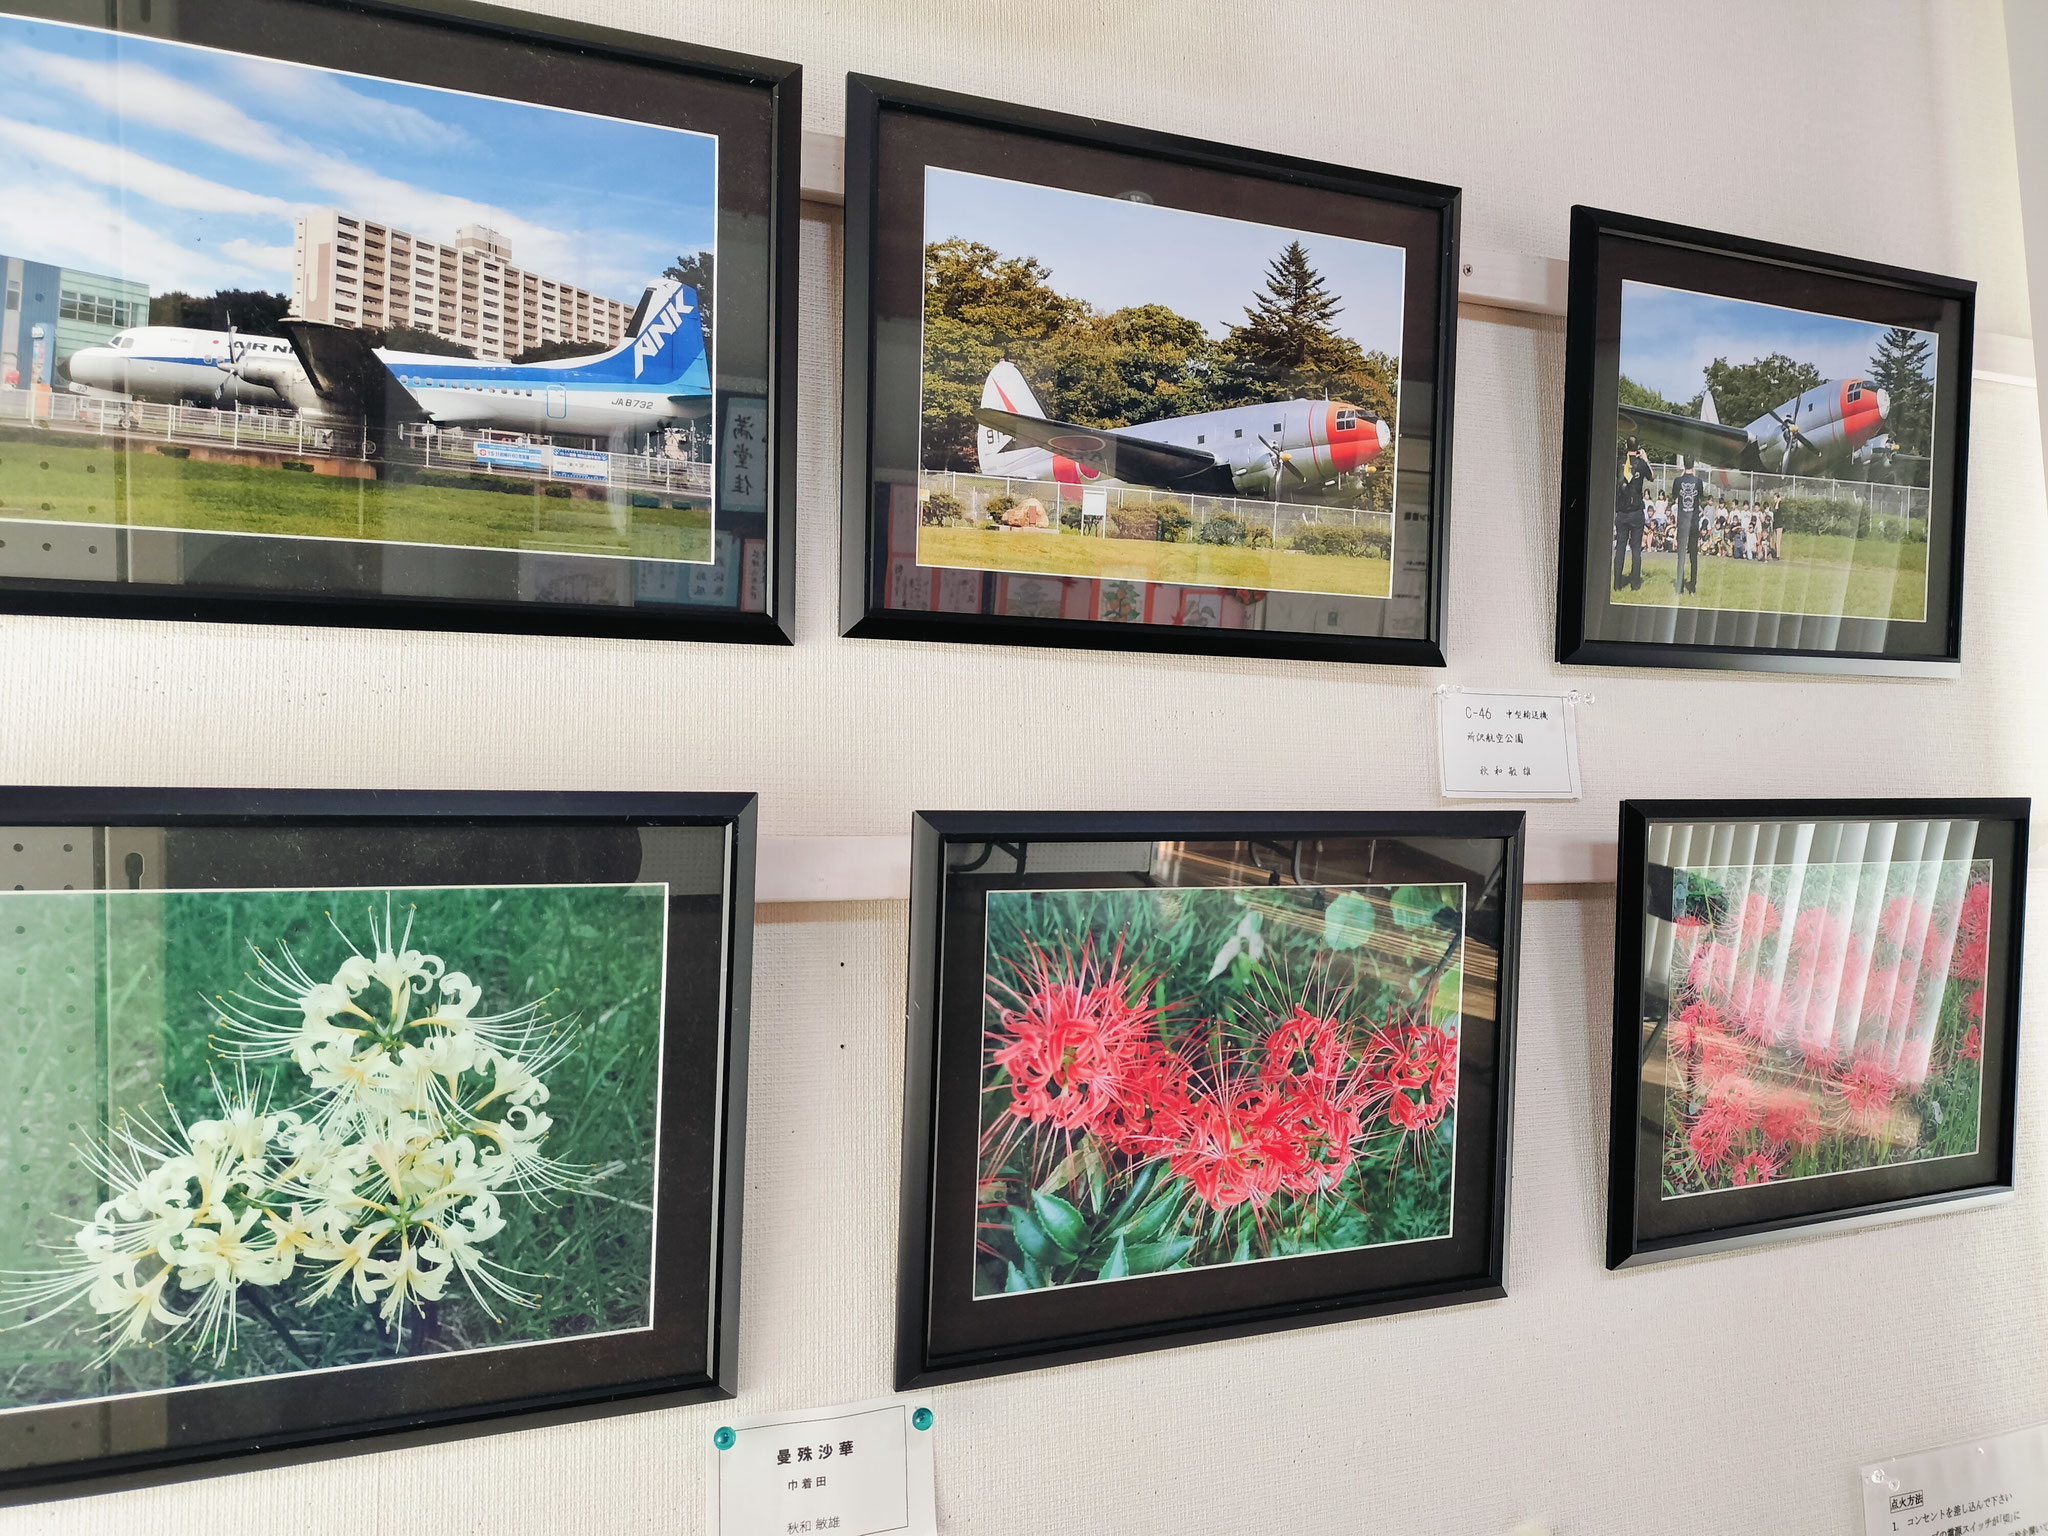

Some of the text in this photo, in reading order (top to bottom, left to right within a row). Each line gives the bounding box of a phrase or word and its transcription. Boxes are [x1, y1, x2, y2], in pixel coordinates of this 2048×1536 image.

[1465, 706, 1492, 720] C-46
[1467, 731, 1524, 744] 所沢航空公園
[777, 1440, 854, 1466] 曼殊沙華
[787, 1475, 827, 1491] 巾着田
[1890, 1492, 1923, 1511] 点火方法
